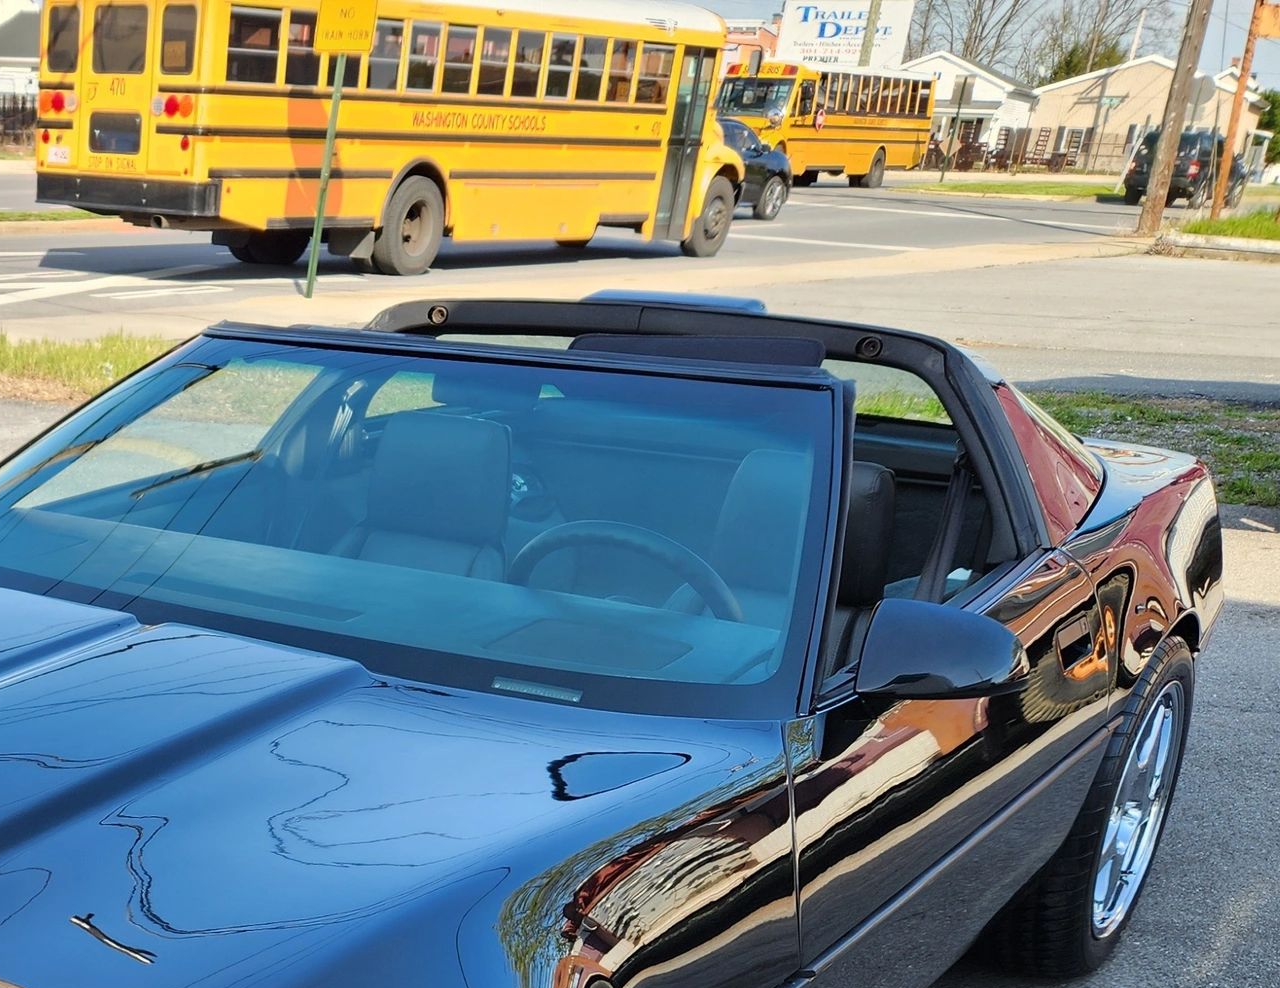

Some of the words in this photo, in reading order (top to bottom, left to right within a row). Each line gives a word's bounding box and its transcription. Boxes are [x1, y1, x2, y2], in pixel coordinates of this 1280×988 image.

[340, 8, 356, 19] NO
[110, 78, 126, 97] 470
[413, 111, 468, 128] WASHINGTON
[471, 113, 507, 130] COUNTY
[508, 115, 547, 132] SCHOOLS
